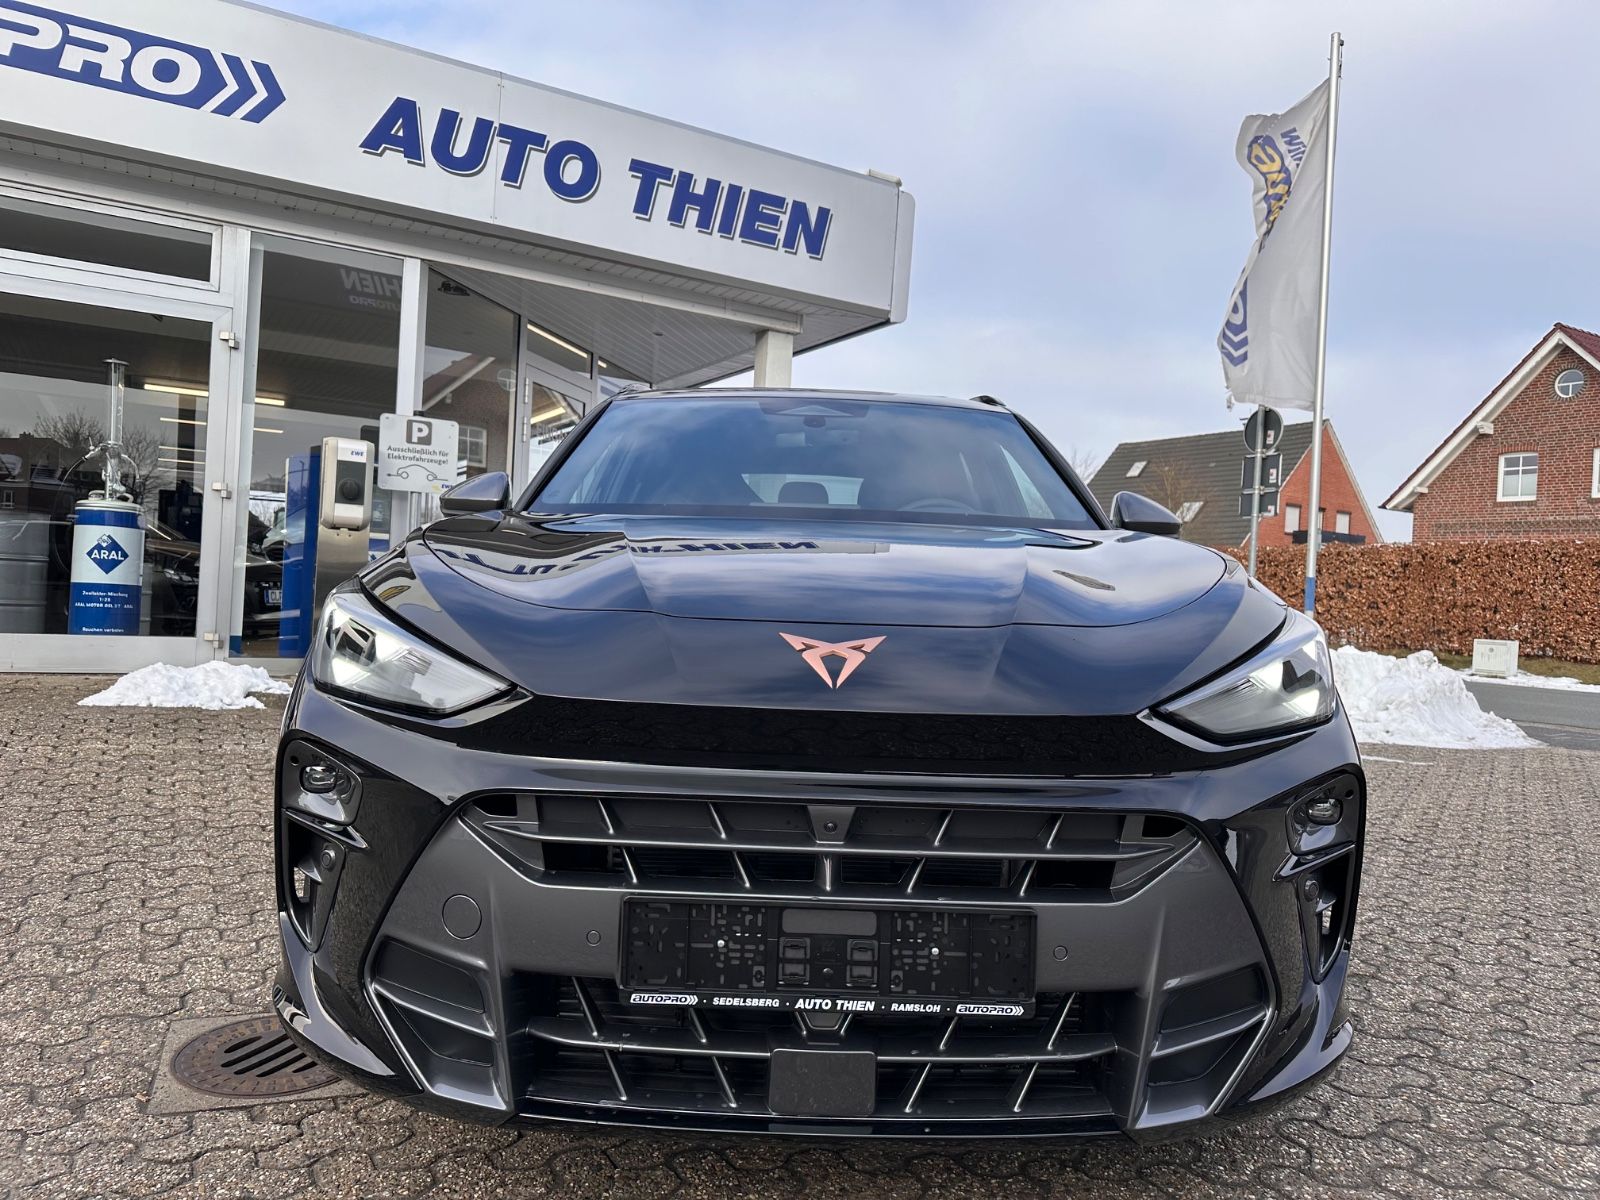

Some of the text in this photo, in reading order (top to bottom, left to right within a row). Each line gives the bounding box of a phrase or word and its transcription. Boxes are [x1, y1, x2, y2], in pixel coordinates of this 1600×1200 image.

[0, 6, 202, 96] PRO
[359, 97, 832, 260] AUTO THIEN
[411, 421, 430, 443] P
[387, 445, 449, 458] Ausschließlich für
[387, 453, 449, 466] Elektrofahrzeuge!
[91, 549, 125, 561] ARAL
[712, 997, 780, 1007] SEDELSBERG
[795, 998, 832, 1010] AUTO
[836, 1000, 876, 1012] THIEN
[890, 1003, 941, 1013] RAMSLOH
